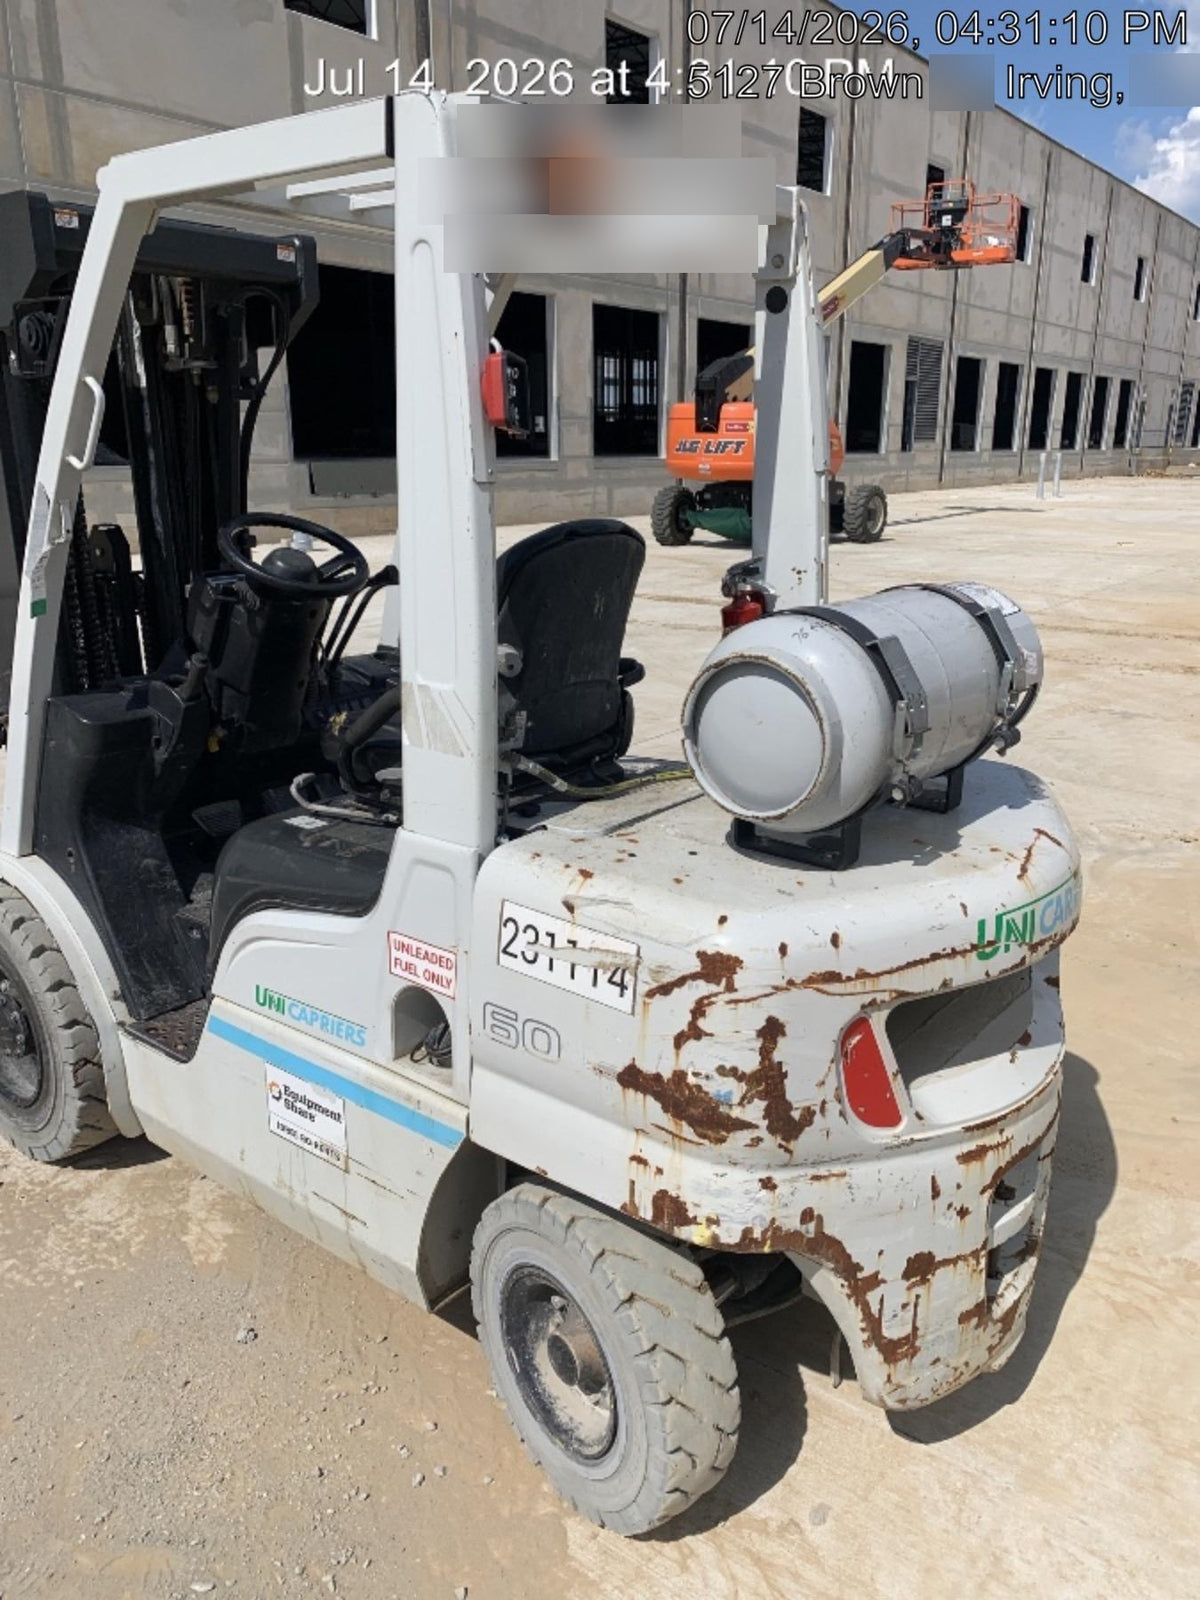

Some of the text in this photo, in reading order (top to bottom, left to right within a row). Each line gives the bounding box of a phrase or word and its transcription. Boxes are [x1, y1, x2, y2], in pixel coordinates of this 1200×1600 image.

[703, 439, 747, 456] LIFT
[394, 938, 455, 971] UNLEADED
[394, 957, 452, 989] FUEL ONLY
[483, 1002, 560, 1063] 60
[283, 1084, 343, 1124] Equipment
